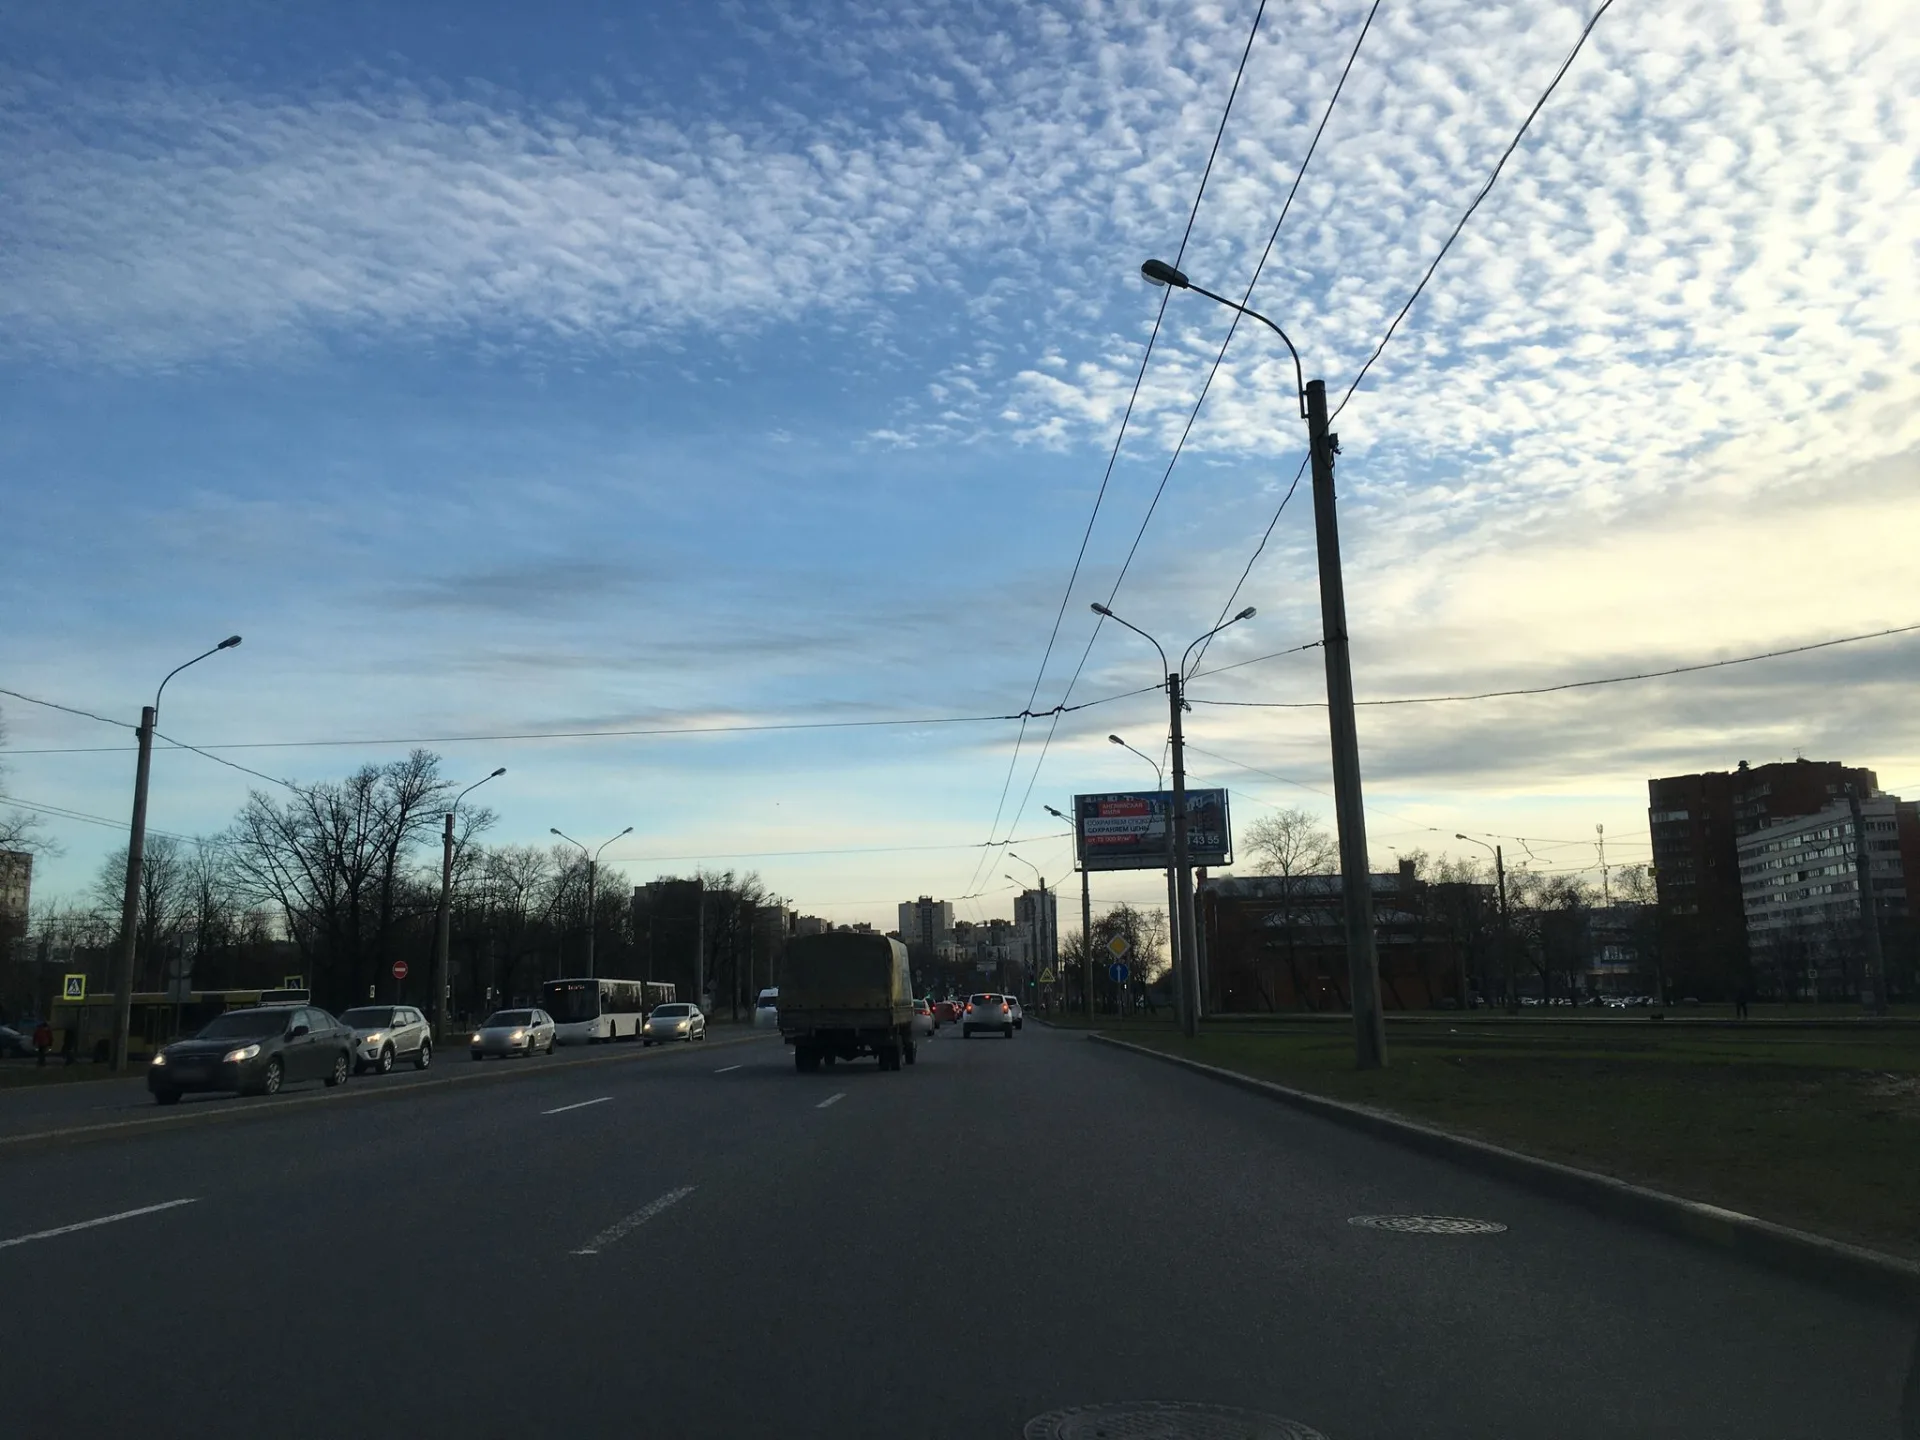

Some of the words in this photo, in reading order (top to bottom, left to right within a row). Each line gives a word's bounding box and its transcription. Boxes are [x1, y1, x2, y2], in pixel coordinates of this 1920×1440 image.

[1088, 826, 1129, 834] СОХРАНЯЕМ
[1192, 836, 1204, 845] 43
[1207, 835, 1220, 844] 55
